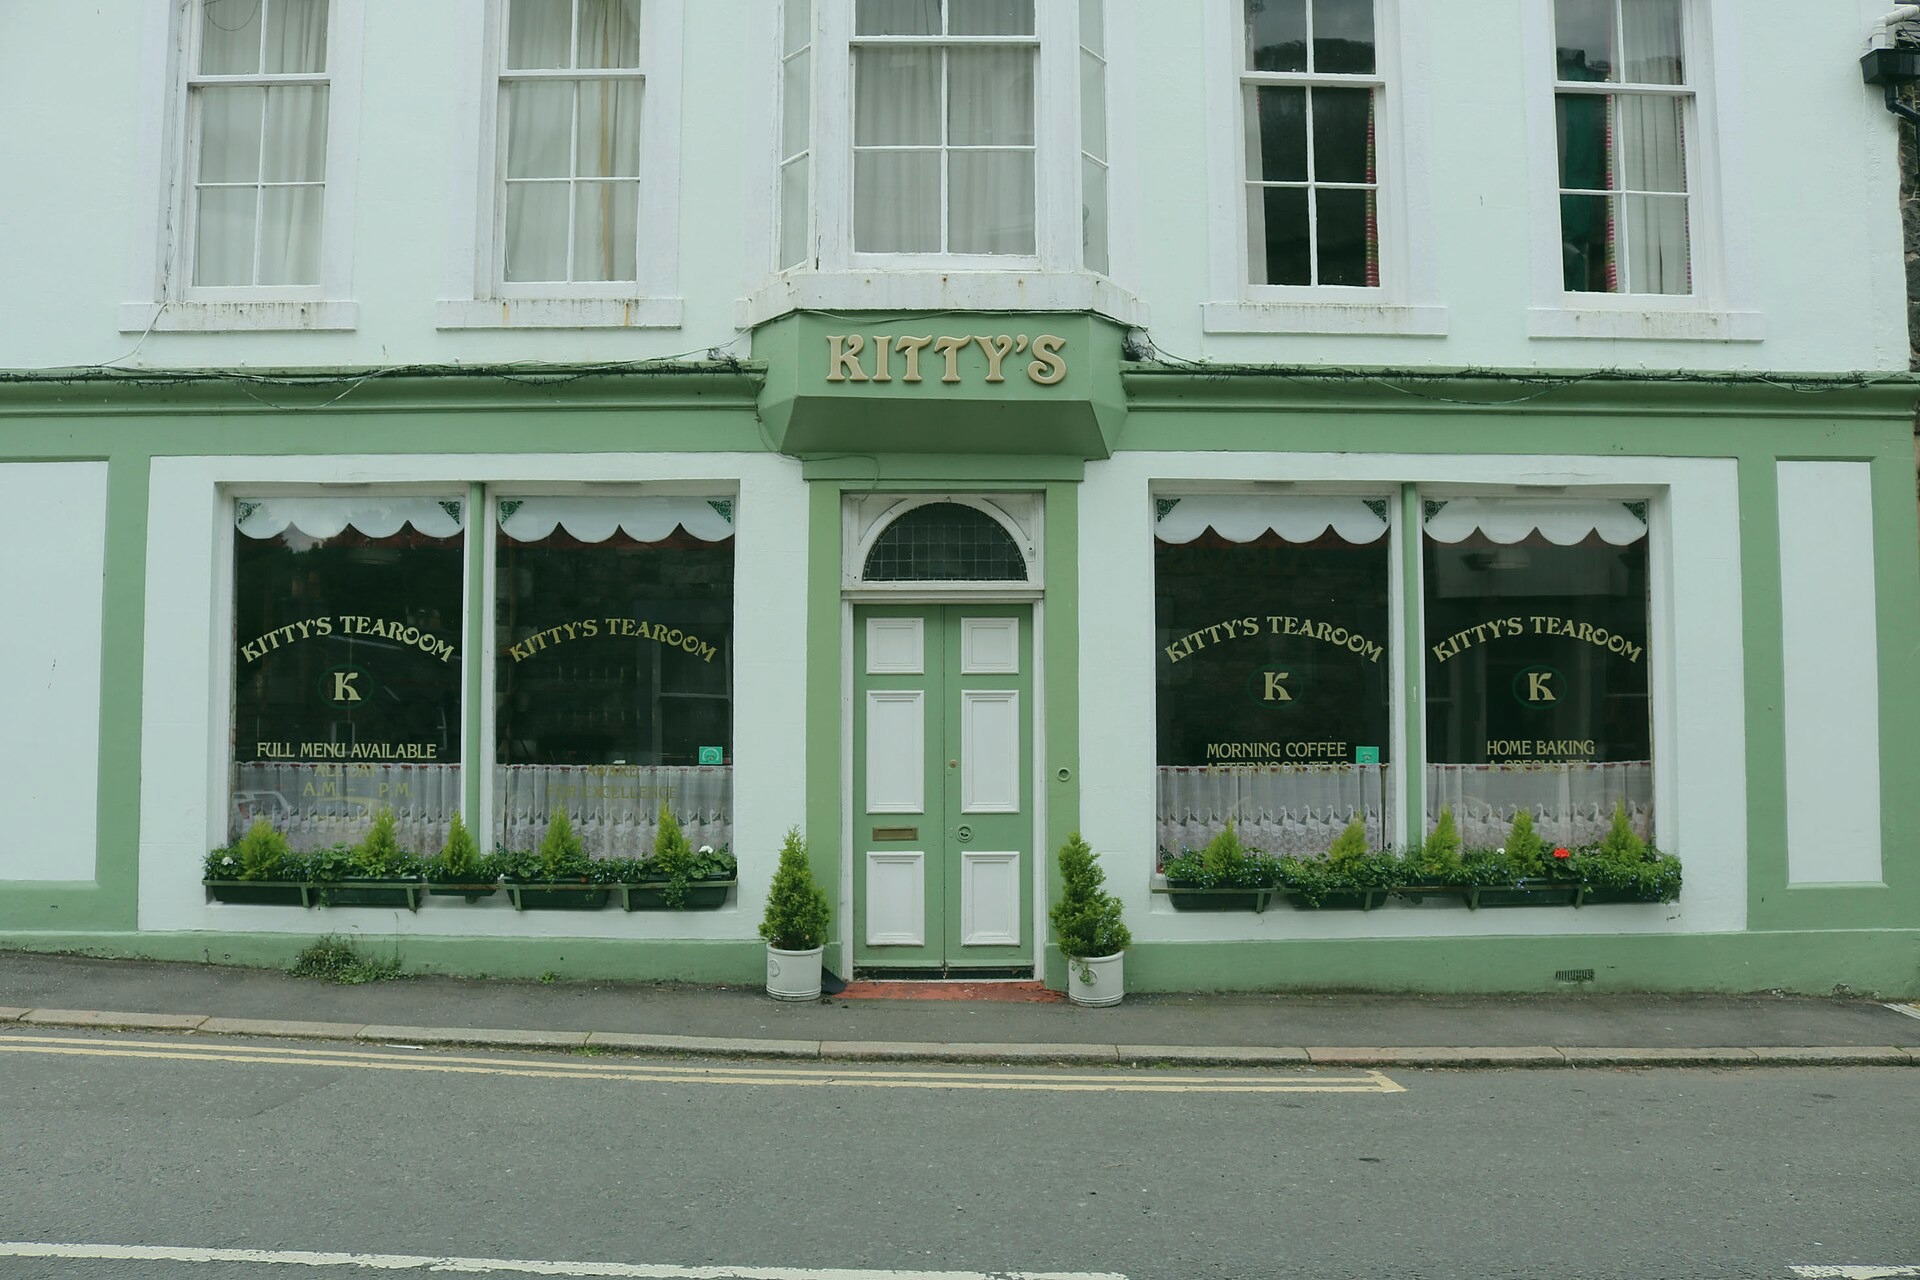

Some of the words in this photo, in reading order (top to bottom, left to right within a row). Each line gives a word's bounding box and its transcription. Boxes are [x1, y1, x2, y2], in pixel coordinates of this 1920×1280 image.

[826, 333, 1067, 385] KITTY'S
[241, 616, 333, 663] KITTY'S
[339, 615, 455, 663] TEAROOM
[508, 619, 598, 663] KITTY'S
[605, 618, 718, 664] TEAROOM
[1165, 616, 1259, 663] KITTY'S
[1267, 615, 1384, 663] TEAROOM
[1431, 617, 1524, 663] KITTY'S
[1530, 616, 1643, 664] TEAROOM
[333, 672, 362, 701] K
[1263, 672, 1292, 701] K
[1528, 672, 1557, 701] K
[256, 742, 295, 758] FULL
[300, 742, 346, 758] MENU
[350, 743, 437, 759] AVAILABLE
[1207, 743, 1281, 758] MORNING
[1286, 742, 1348, 758] COFFEE
[1487, 740, 1532, 755] HOME
[1536, 740, 1595, 755] BAKING
